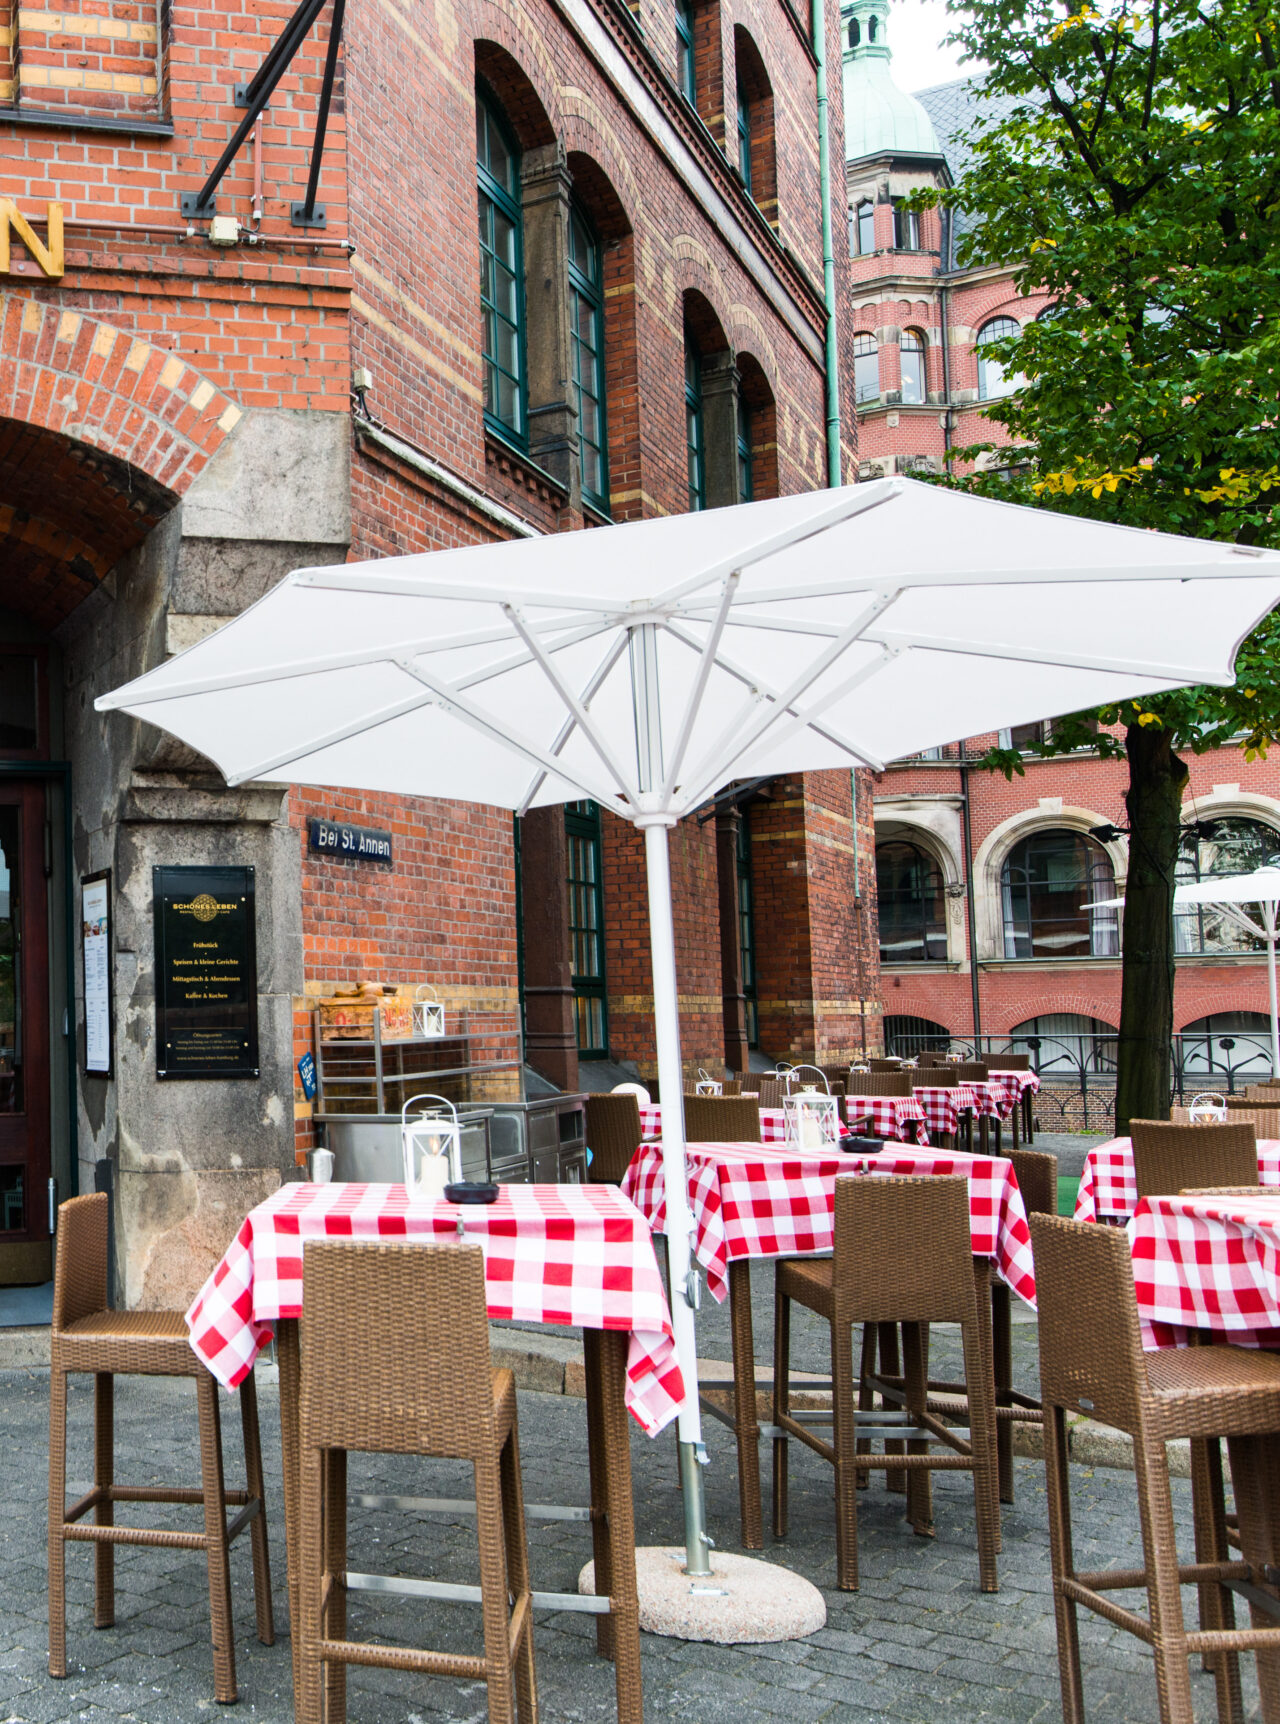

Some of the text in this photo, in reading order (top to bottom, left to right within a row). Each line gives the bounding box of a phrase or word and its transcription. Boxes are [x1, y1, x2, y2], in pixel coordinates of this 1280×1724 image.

[318, 824, 389, 856] Bei St. Annen
